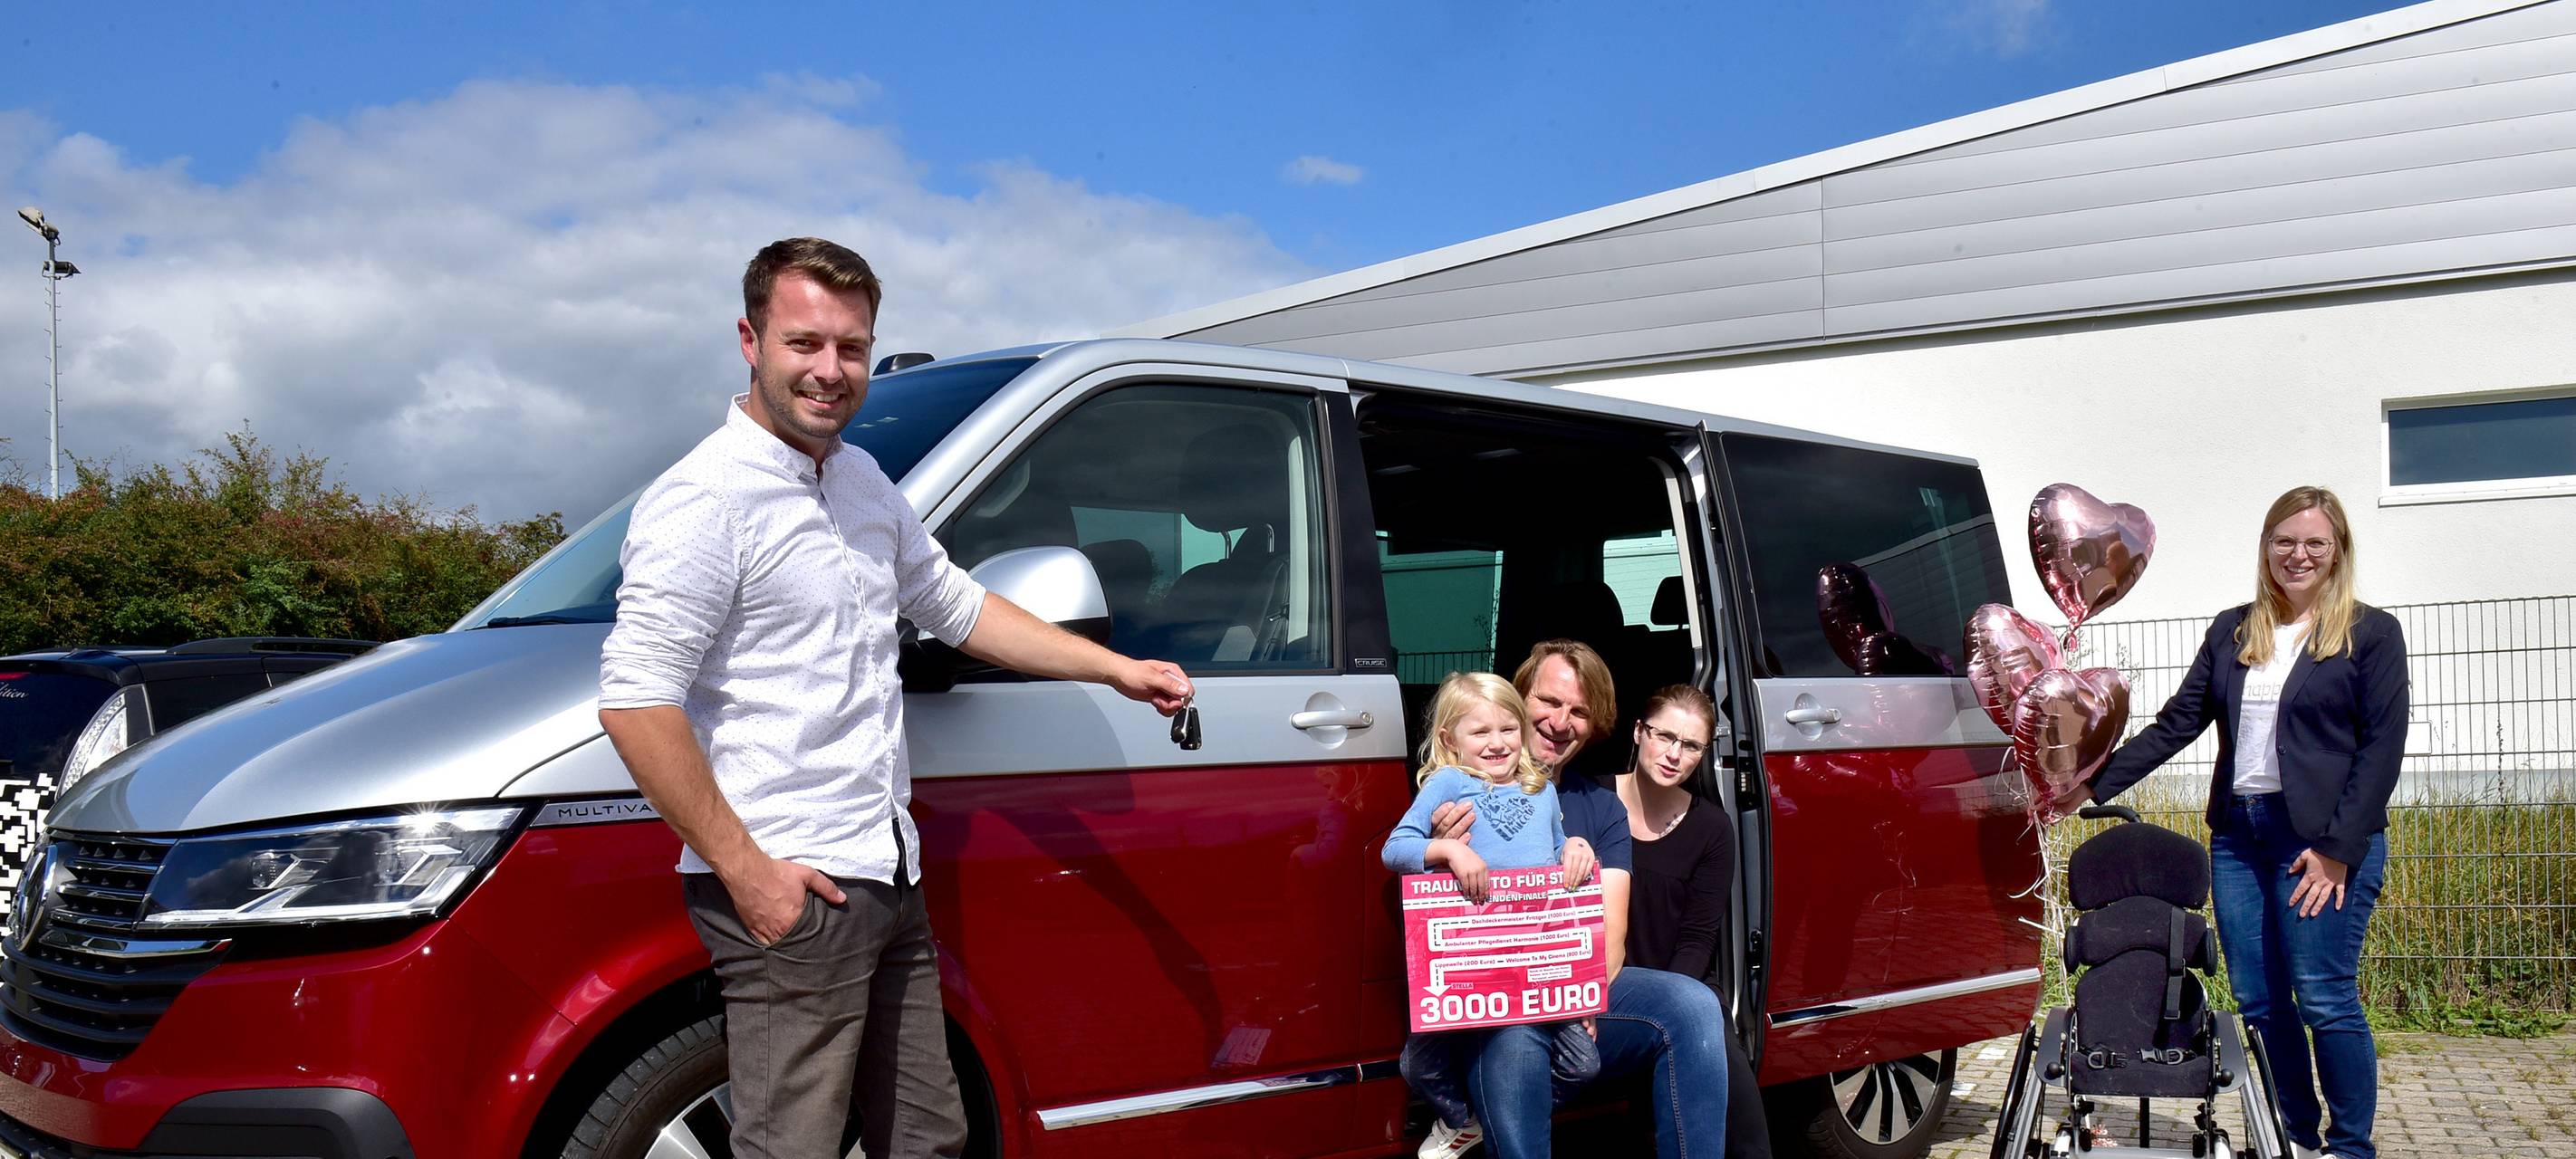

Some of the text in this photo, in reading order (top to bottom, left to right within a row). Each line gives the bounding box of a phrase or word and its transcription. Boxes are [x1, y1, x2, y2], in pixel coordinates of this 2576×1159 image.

[558, 803, 653, 818] MULTIVA
[1410, 870, 1594, 895] TRAUMTO FÜR STA
[1489, 892, 1548, 903] ENDENFINALE
[1472, 915, 1524, 924] Dachdeckermeister
[1419, 981, 1601, 1024] 3000 EURO
